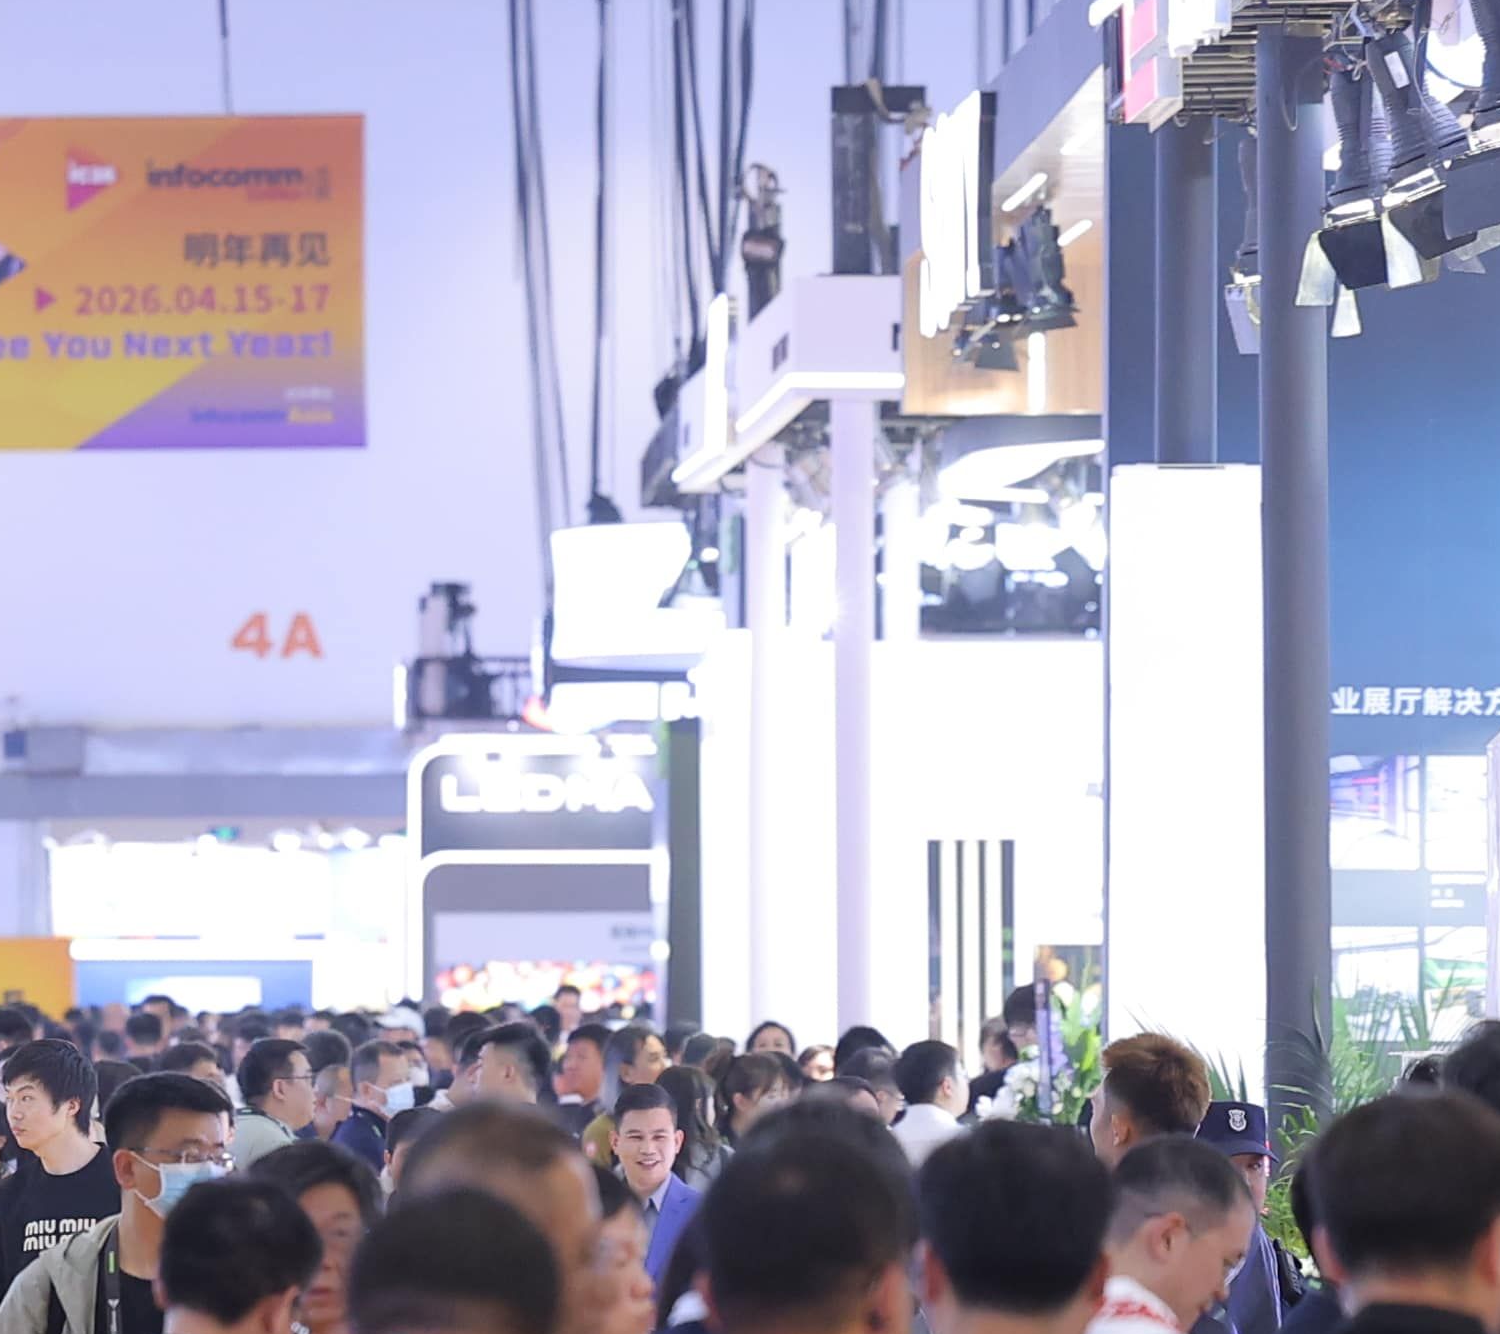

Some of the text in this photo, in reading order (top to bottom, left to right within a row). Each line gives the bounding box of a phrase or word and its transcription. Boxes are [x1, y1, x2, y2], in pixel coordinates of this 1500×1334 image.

[184, 231, 331, 269] 明年再见
[75, 284, 331, 316] 2026.04.15-17
[43, 331, 111, 360] You
[123, 329, 213, 359] Next
[228, 329, 334, 359] Year!
[230, 610, 323, 660] 4A
